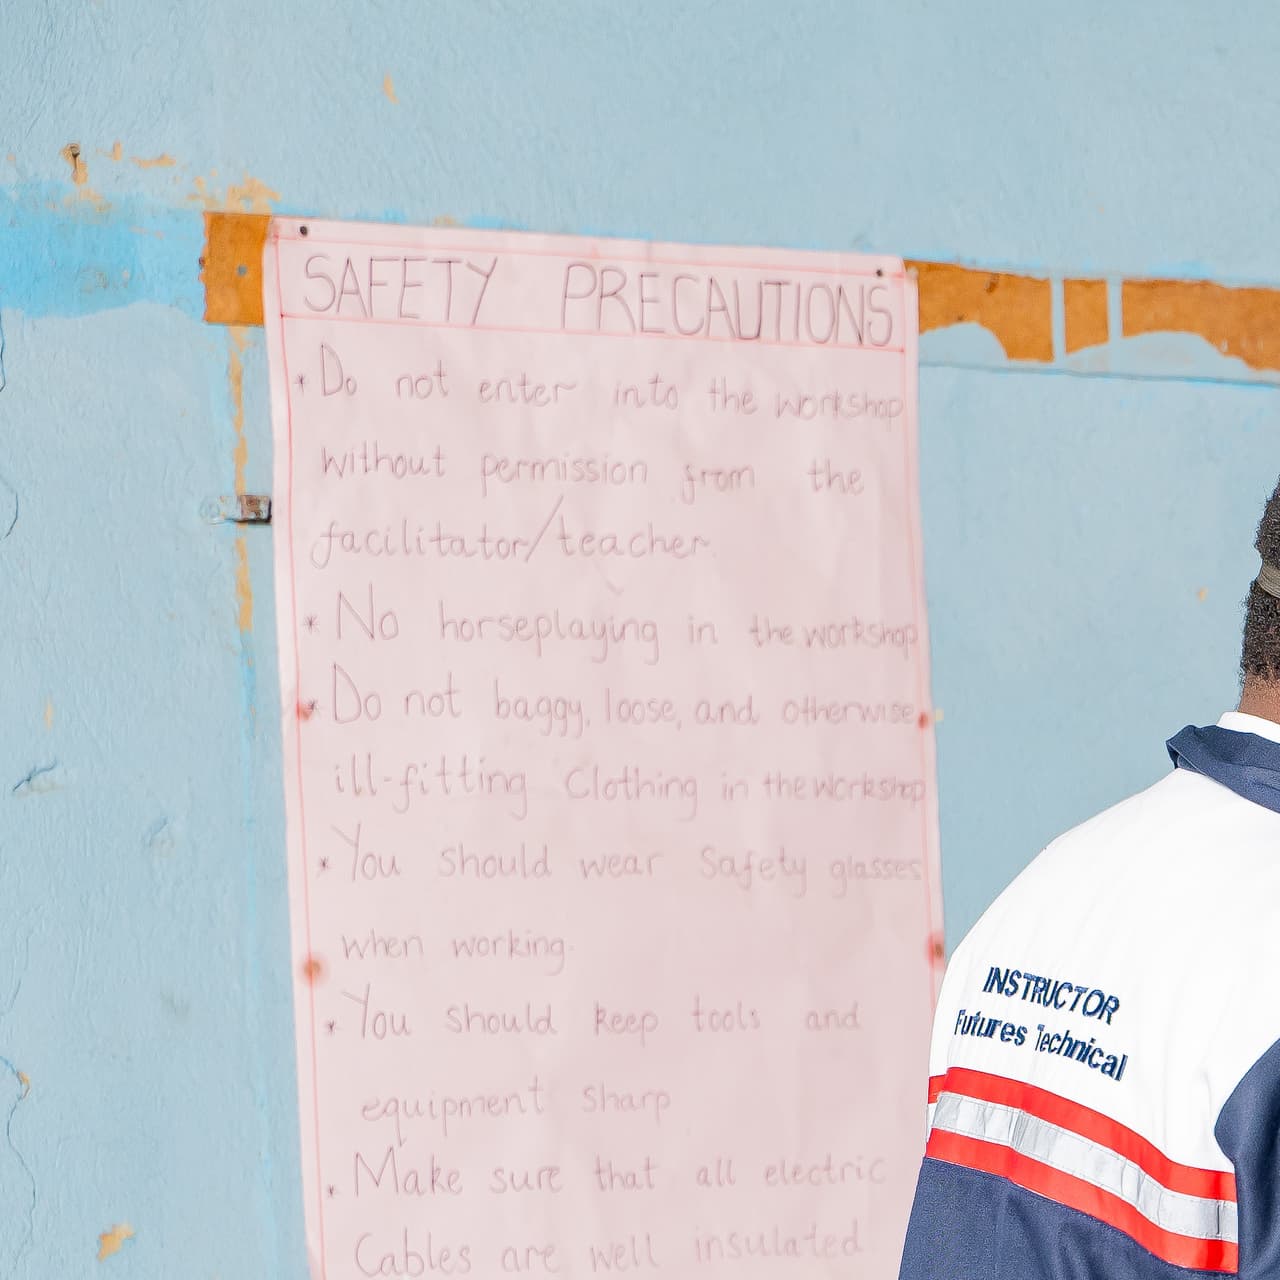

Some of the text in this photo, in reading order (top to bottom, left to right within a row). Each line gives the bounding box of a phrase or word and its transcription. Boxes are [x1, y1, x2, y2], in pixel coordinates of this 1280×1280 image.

[303, 254, 894, 347] SAFETY PRECAUTIONS
[320, 343, 358, 398] Do
[396, 360, 449, 399] not
[478, 373, 577, 406] enter
[613, 372, 679, 410] into
[707, 376, 758, 417] the
[321, 439, 446, 480] without
[480, 454, 648, 498] permission
[807, 455, 866, 496] the
[335, 583, 399, 641] No
[440, 600, 658, 665] horseplaying
[688, 616, 719, 645] in
[750, 608, 793, 647] the
[332, 662, 382, 724] Do
[405, 671, 461, 718] not
[696, 693, 760, 726] and
[782, 693, 914, 724] otherwise
[722, 770, 749, 801] in
[762, 770, 806, 802] the
[332, 822, 402, 883] You
[578, 850, 664, 880] wear
[830, 850, 922, 897] glasses
[341, 928, 424, 961] when
[339, 983, 412, 1040] You
[692, 994, 761, 1034] tools
[803, 1001, 861, 1033] and
[982, 966, 1120, 1026] INSTRUCTOR
[954, 1008, 1129, 1082] Futures Technical
[353, 1145, 887, 1199] Make sure that all electric
[353, 1227, 473, 1280] Cables
[500, 1241, 561, 1275] are
[591, 1232, 660, 1272] well
